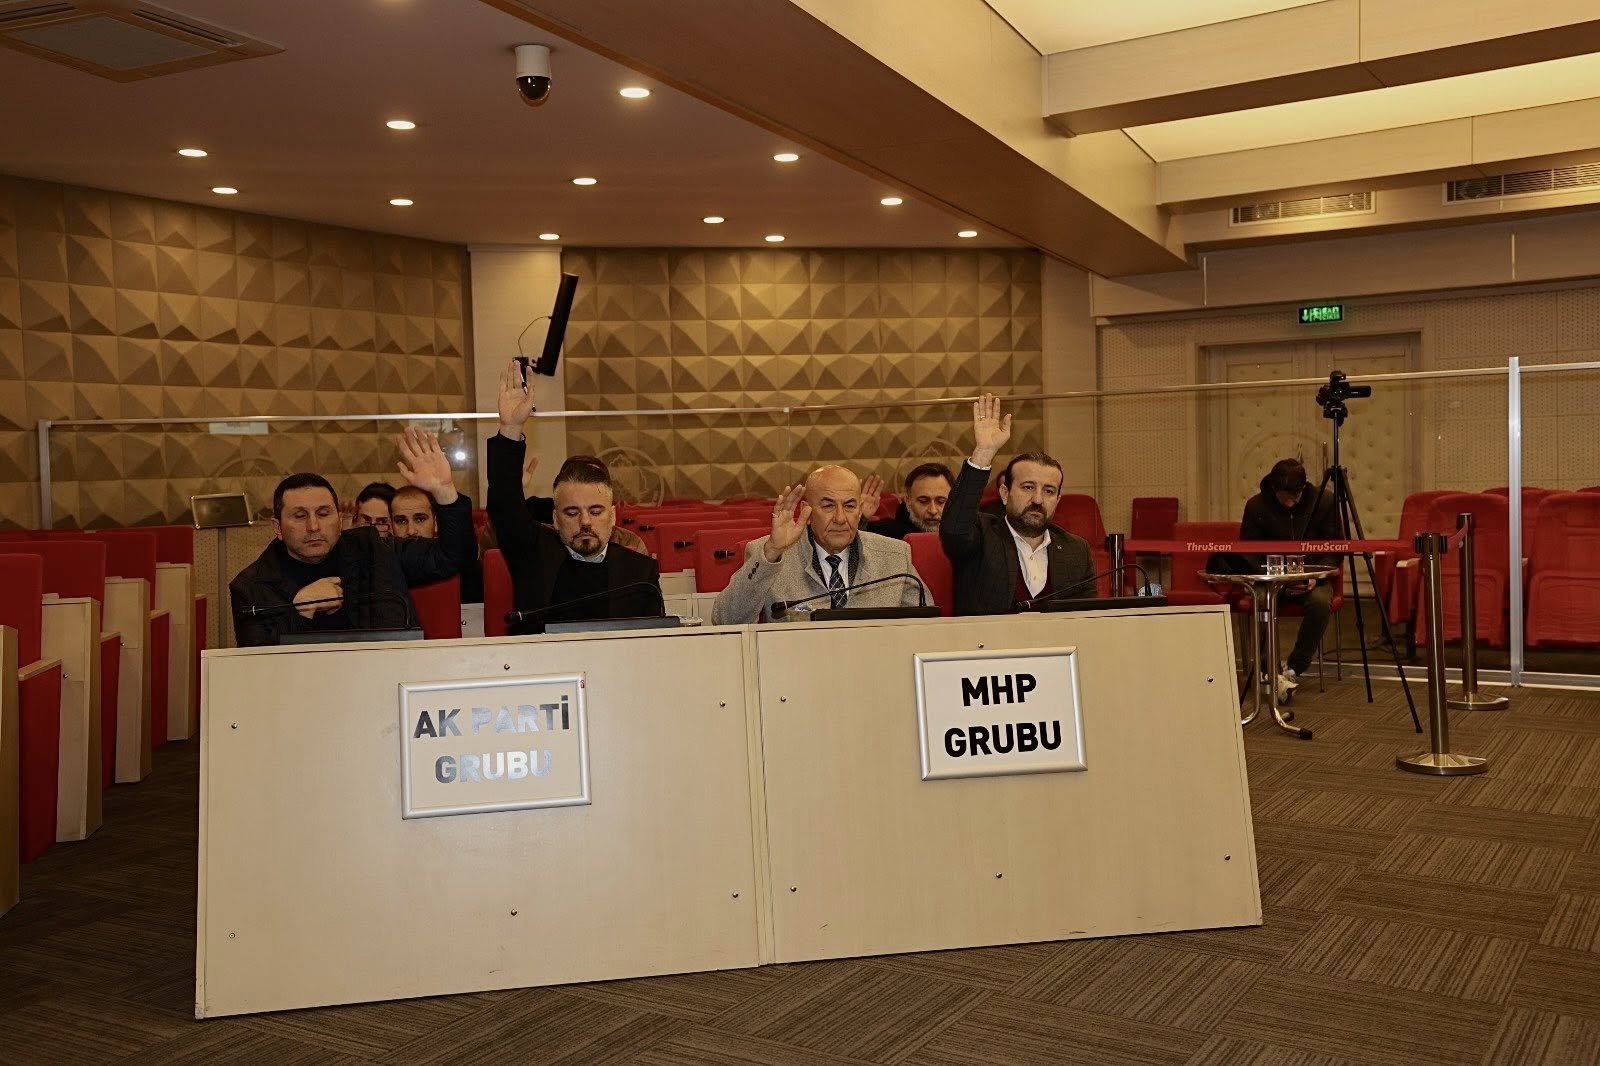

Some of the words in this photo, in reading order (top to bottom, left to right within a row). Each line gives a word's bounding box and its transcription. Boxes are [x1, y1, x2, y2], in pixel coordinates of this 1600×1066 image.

[1186, 542, 1232, 551] ThruScan
[1300, 541, 1349, 552] ThruScan
[961, 673, 1037, 707] MHP
[413, 708, 463, 739] AK
[471, 695, 570, 735] PARTİ
[944, 720, 1062, 758] GRUBU
[435, 750, 553, 784] GRUBU
